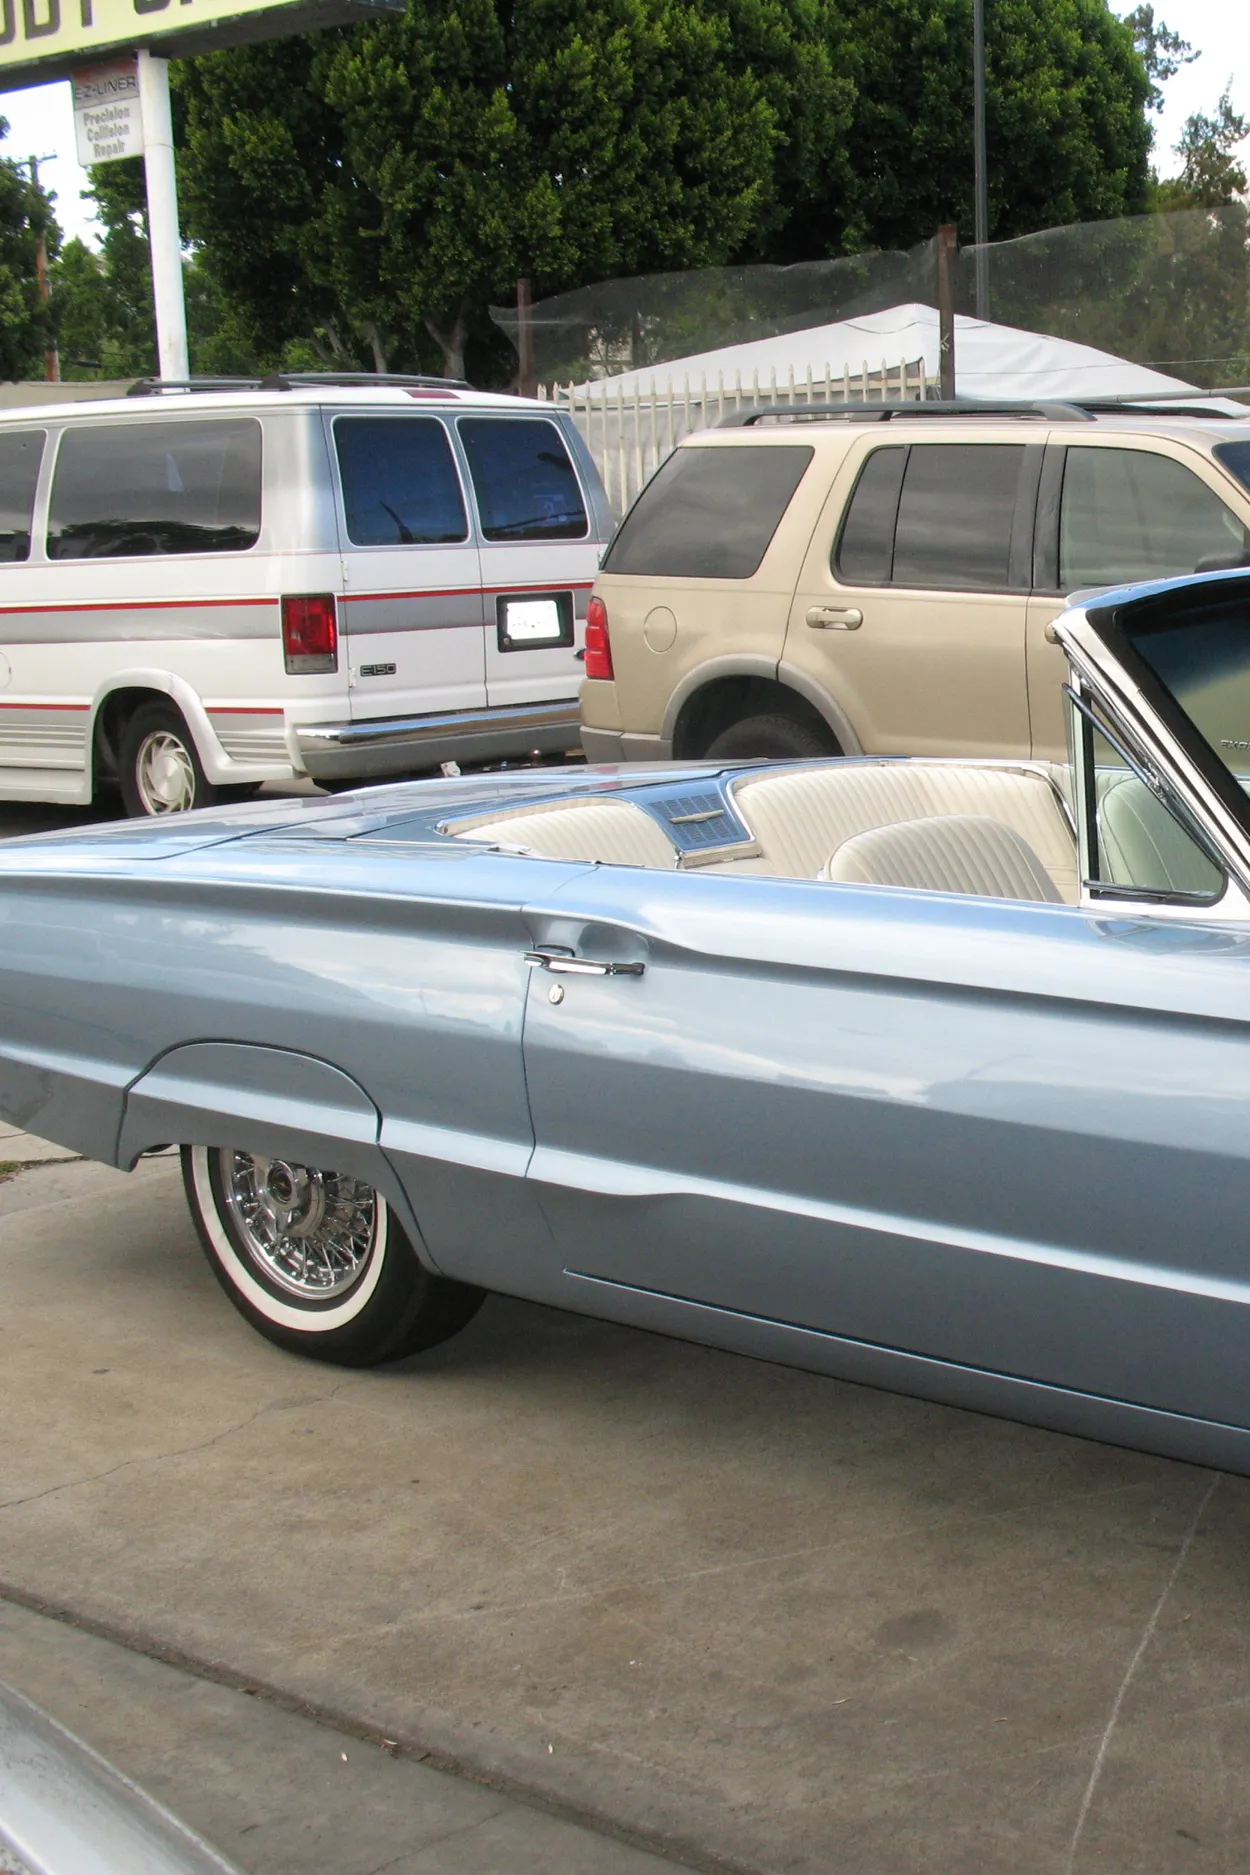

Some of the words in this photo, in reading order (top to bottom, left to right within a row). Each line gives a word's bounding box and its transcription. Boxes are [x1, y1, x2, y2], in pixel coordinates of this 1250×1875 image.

[75, 75, 136, 100] EZ-LINER
[83, 106, 131, 127] Precision
[87, 123, 130, 143] Collision
[93, 139, 125, 158] Repair
